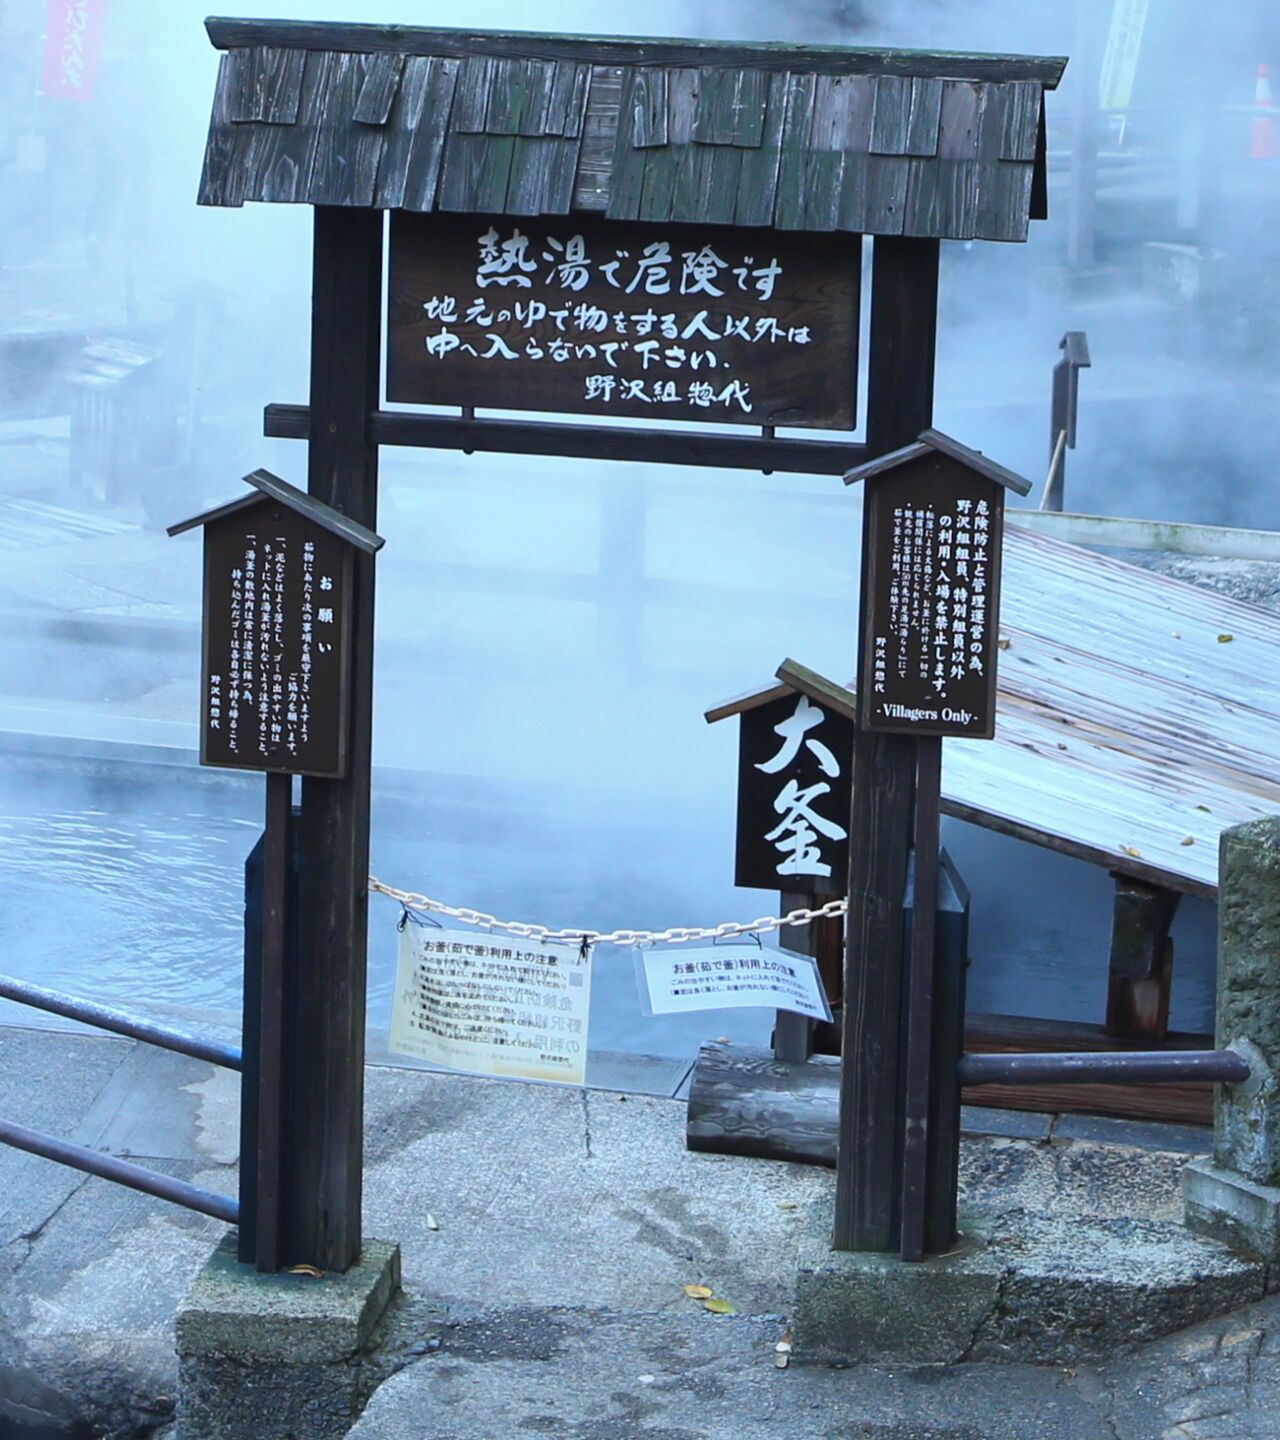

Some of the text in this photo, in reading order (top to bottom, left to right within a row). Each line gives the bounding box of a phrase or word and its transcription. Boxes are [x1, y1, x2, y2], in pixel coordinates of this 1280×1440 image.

[475, 225, 782, 300] 熱湯で危険です
[422, 296, 811, 344] 地元のゆで物をする人以外は
[584, 374, 753, 413] 野沢組惣代
[317, 575, 334, 653] お願い
[949, 499, 972, 680] 野沢組組員、特別組員以外
[968, 499, 990, 678] 危険防止と管理運営の為、
[210, 675, 222, 729] 野沢組惣代
[874, 636, 887, 694] 野沢組惣代
[753, 694, 848, 878] 大釜
